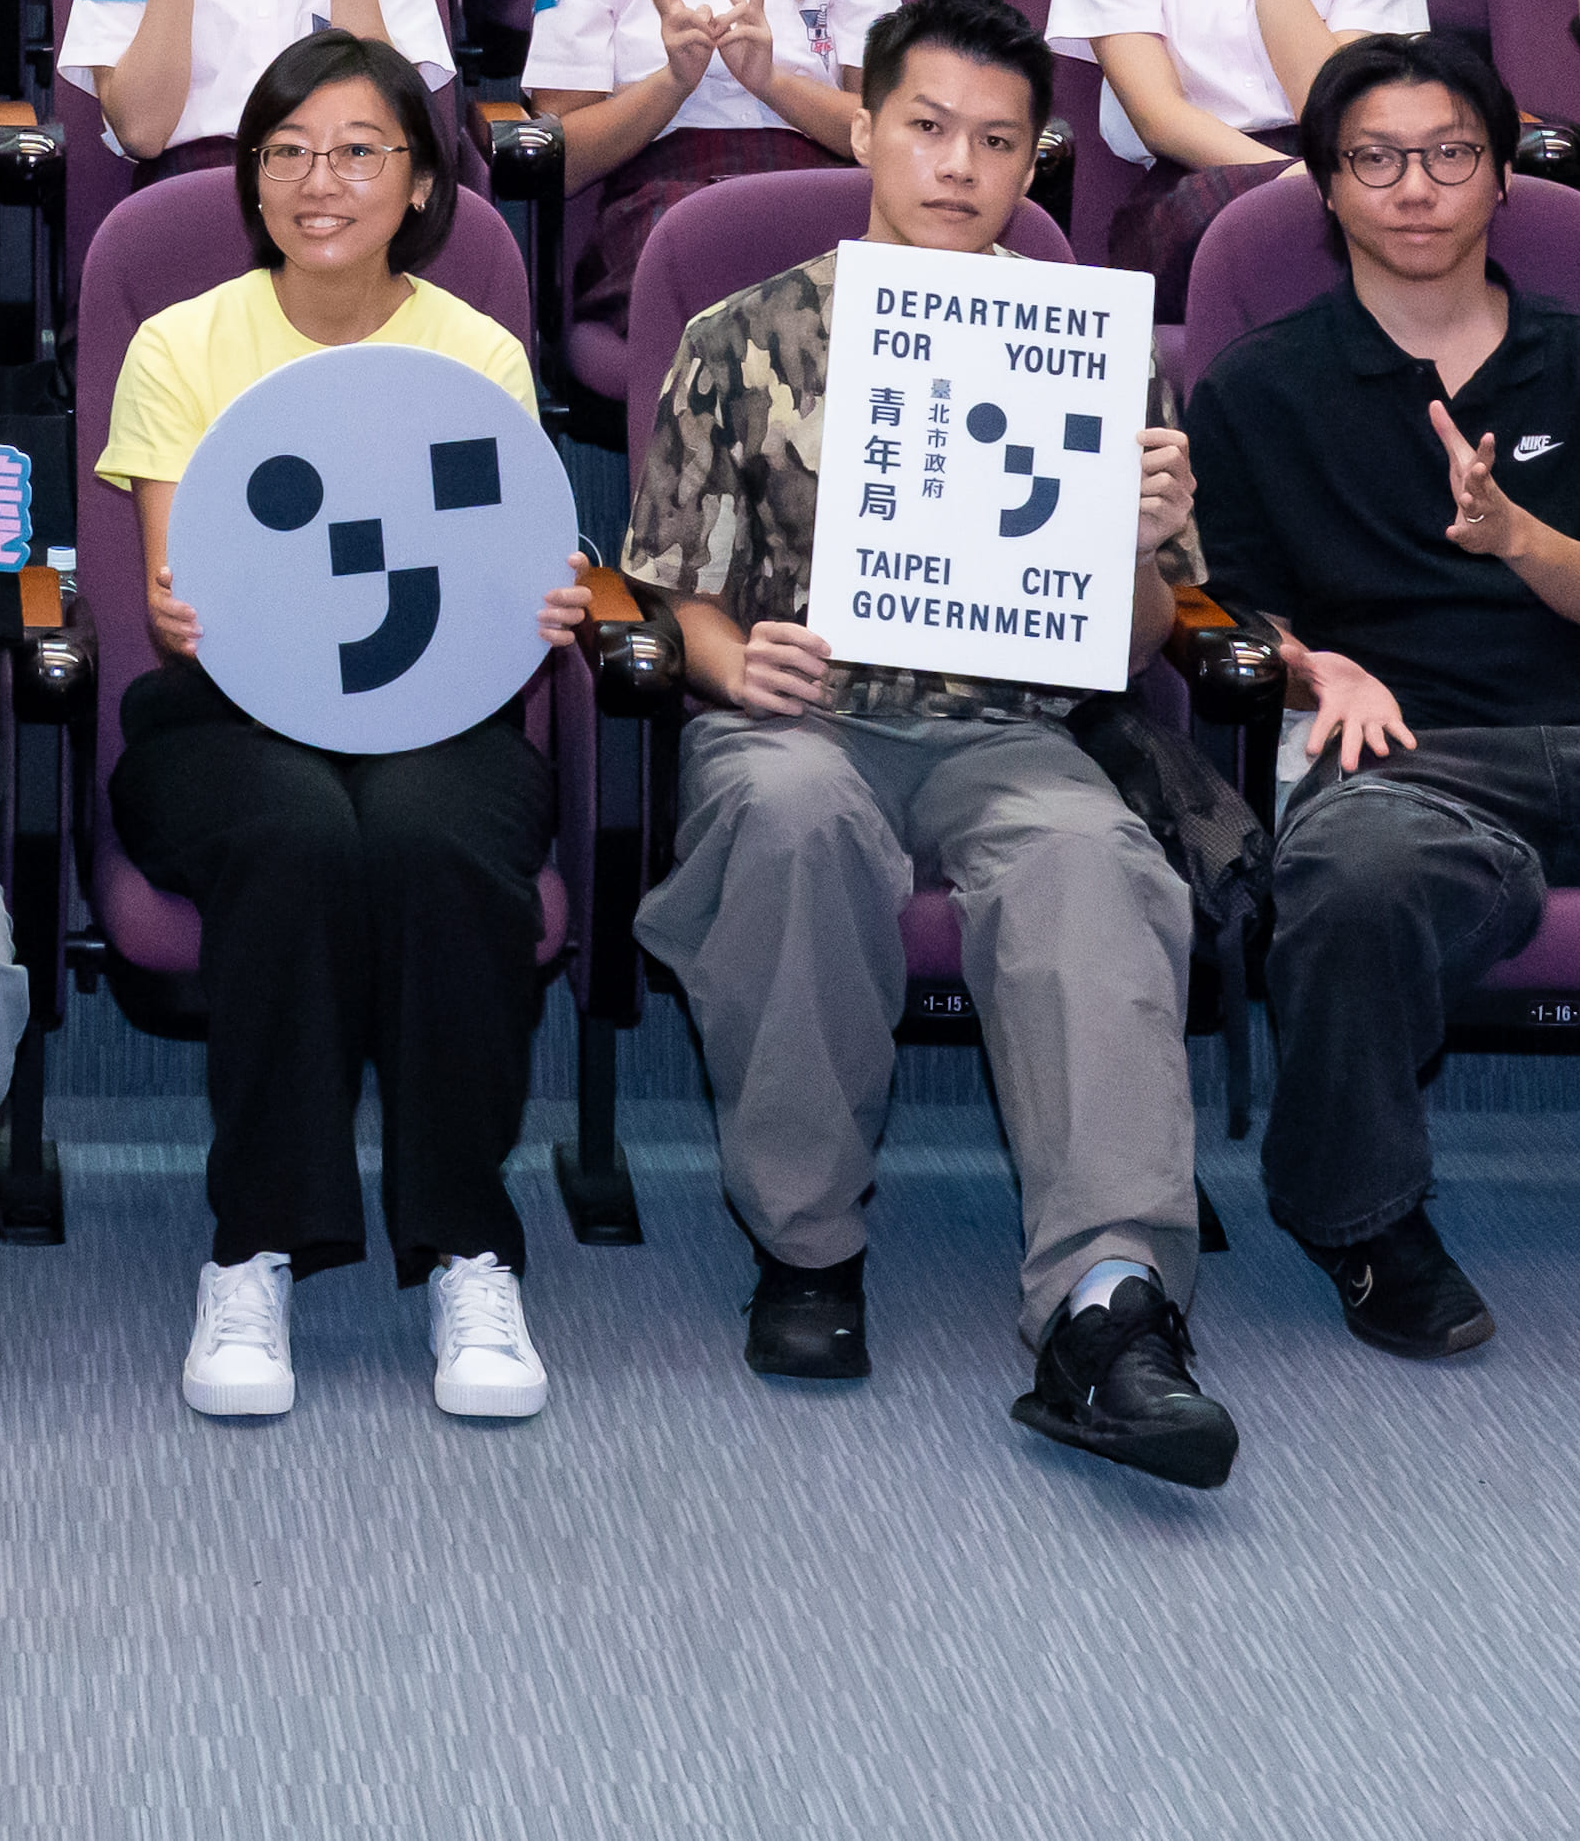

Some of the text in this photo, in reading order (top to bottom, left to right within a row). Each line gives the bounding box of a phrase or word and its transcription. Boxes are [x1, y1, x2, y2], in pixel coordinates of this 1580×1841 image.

[876, 286, 1110, 340] DEPARTMENT
[873, 329, 1106, 382] FOR YOUTH
[858, 386, 905, 522] 青年局
[921, 376, 952, 499] 臺北市政府
[1520, 435, 1552, 450] NIKE
[856, 548, 1093, 600] TAIPEI CITY
[852, 590, 1089, 643] GOVERNMENT
[929, 995, 962, 1012] 1-15
[1538, 1005, 1571, 1021] 1-16
